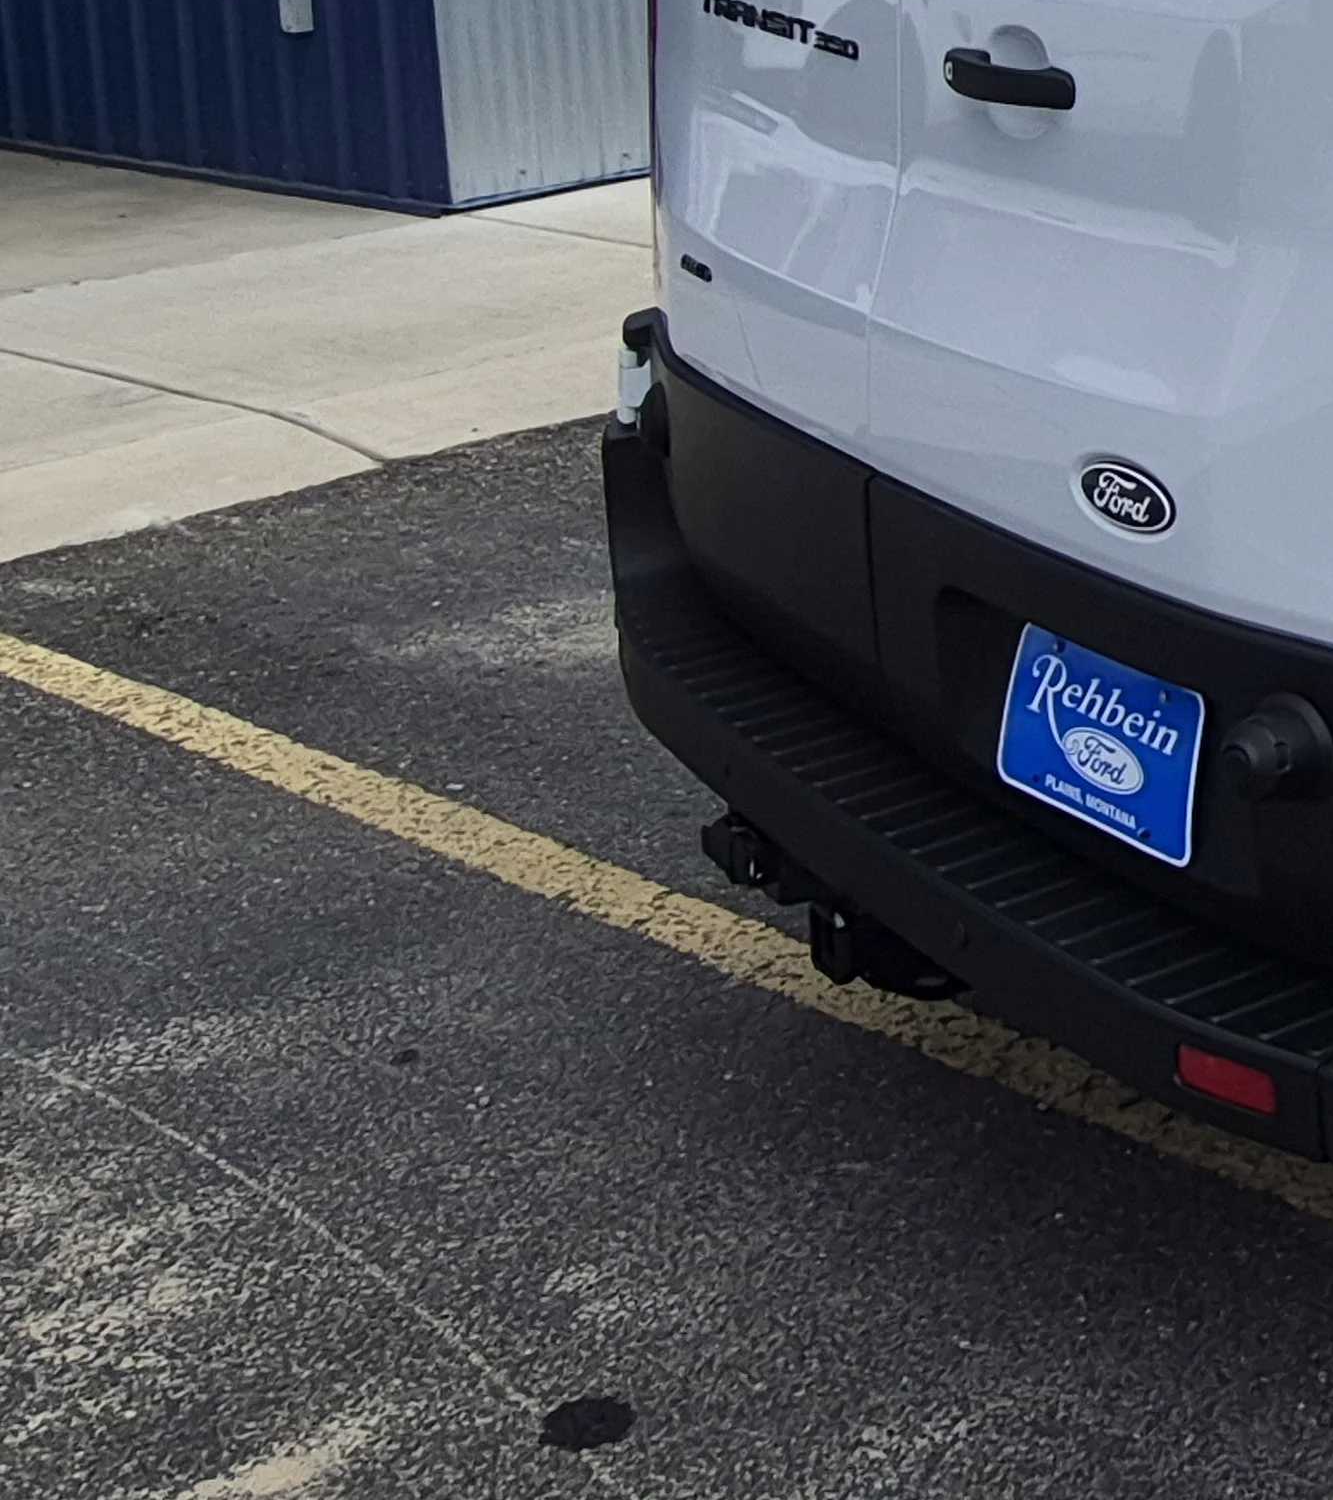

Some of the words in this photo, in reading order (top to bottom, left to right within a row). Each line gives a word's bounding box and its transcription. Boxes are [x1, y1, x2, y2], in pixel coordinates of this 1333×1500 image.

[1093, 471, 1151, 523] Ford
[1026, 654, 1178, 755] Rehbein
[1077, 735, 1127, 785] Ford
[1086, 793, 1137, 830] MONTANA
